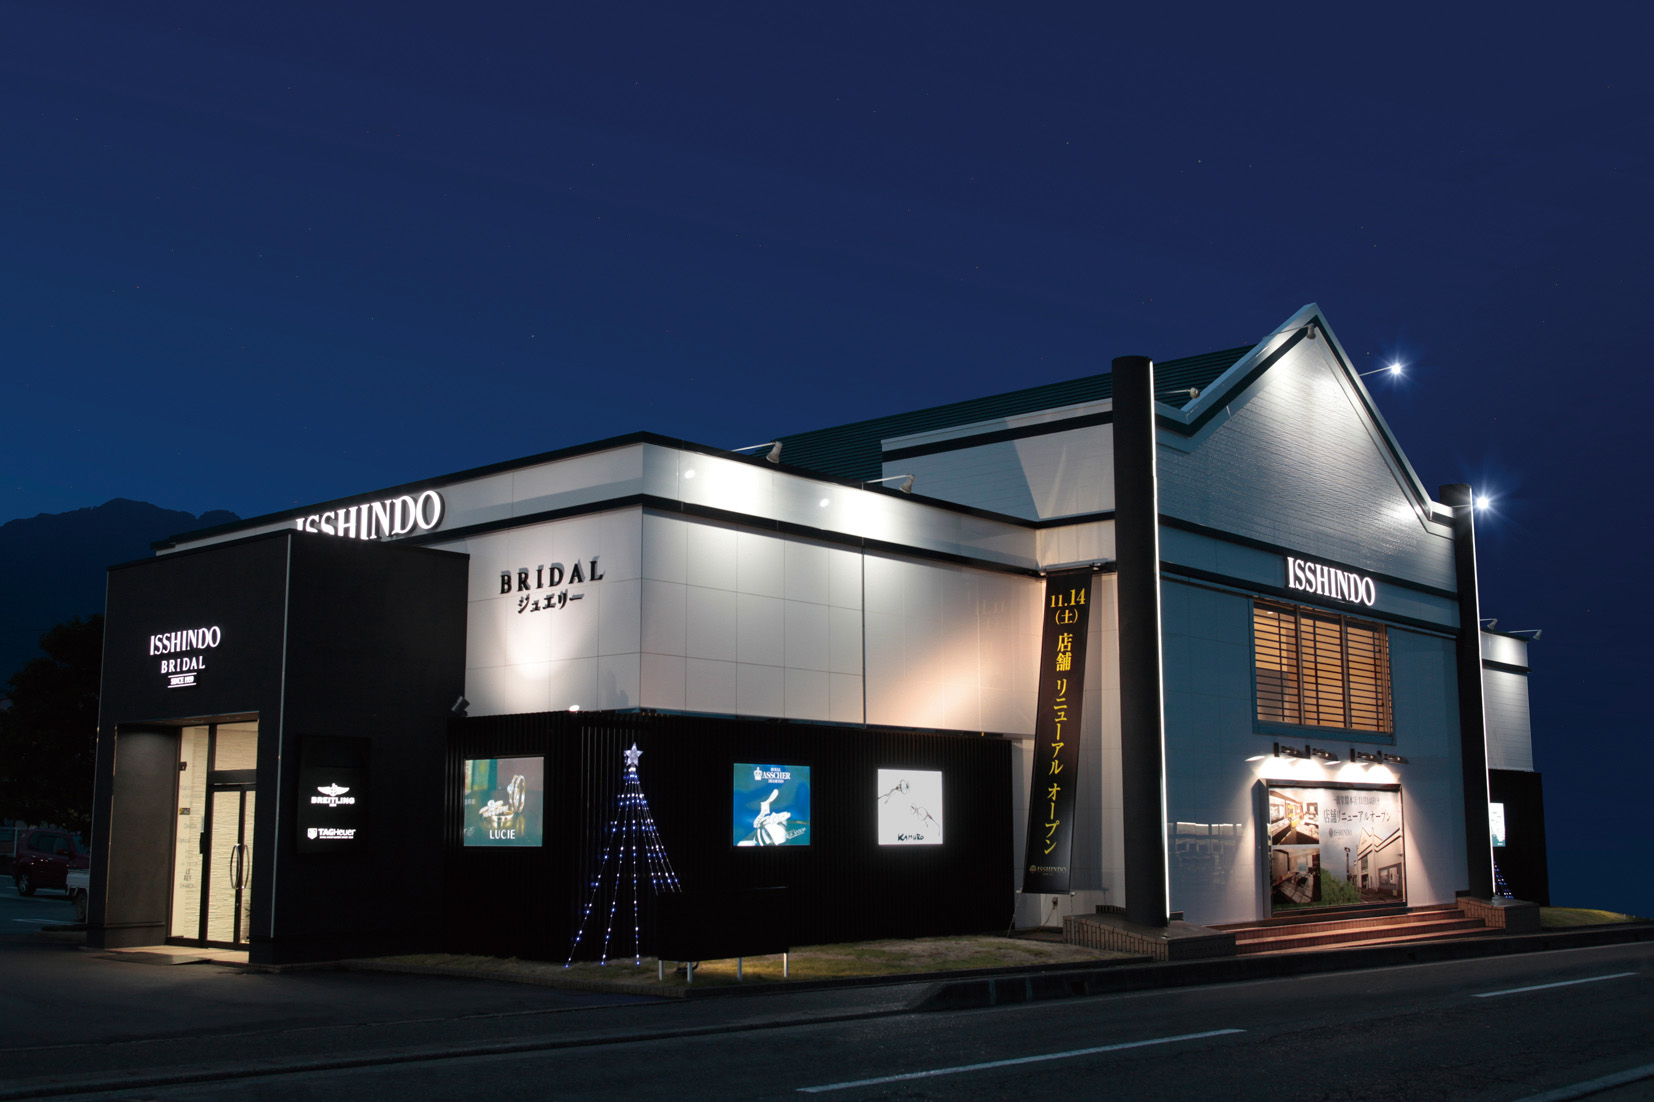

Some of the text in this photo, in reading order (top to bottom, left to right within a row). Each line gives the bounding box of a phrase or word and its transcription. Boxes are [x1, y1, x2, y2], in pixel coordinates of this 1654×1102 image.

[500, 558, 604, 595] BRIDAL
[1287, 556, 1376, 607] ISSHINDO
[517, 590, 584, 614] ジュエリー
[1050, 587, 1086, 608] 11.14
[1055, 608, 1079, 625] (土)
[149, 625, 221, 656] ISSHINDO
[1056, 632, 1073, 672] 店舗
[160, 655, 206, 674] BRIDAL
[1048, 678, 1068, 775] リニューアル
[762, 771, 791, 780] ASSCHER
[311, 796, 355, 804] BREITLING
[1044, 782, 1061, 855] オープン
[489, 829, 516, 840] LUCIE
